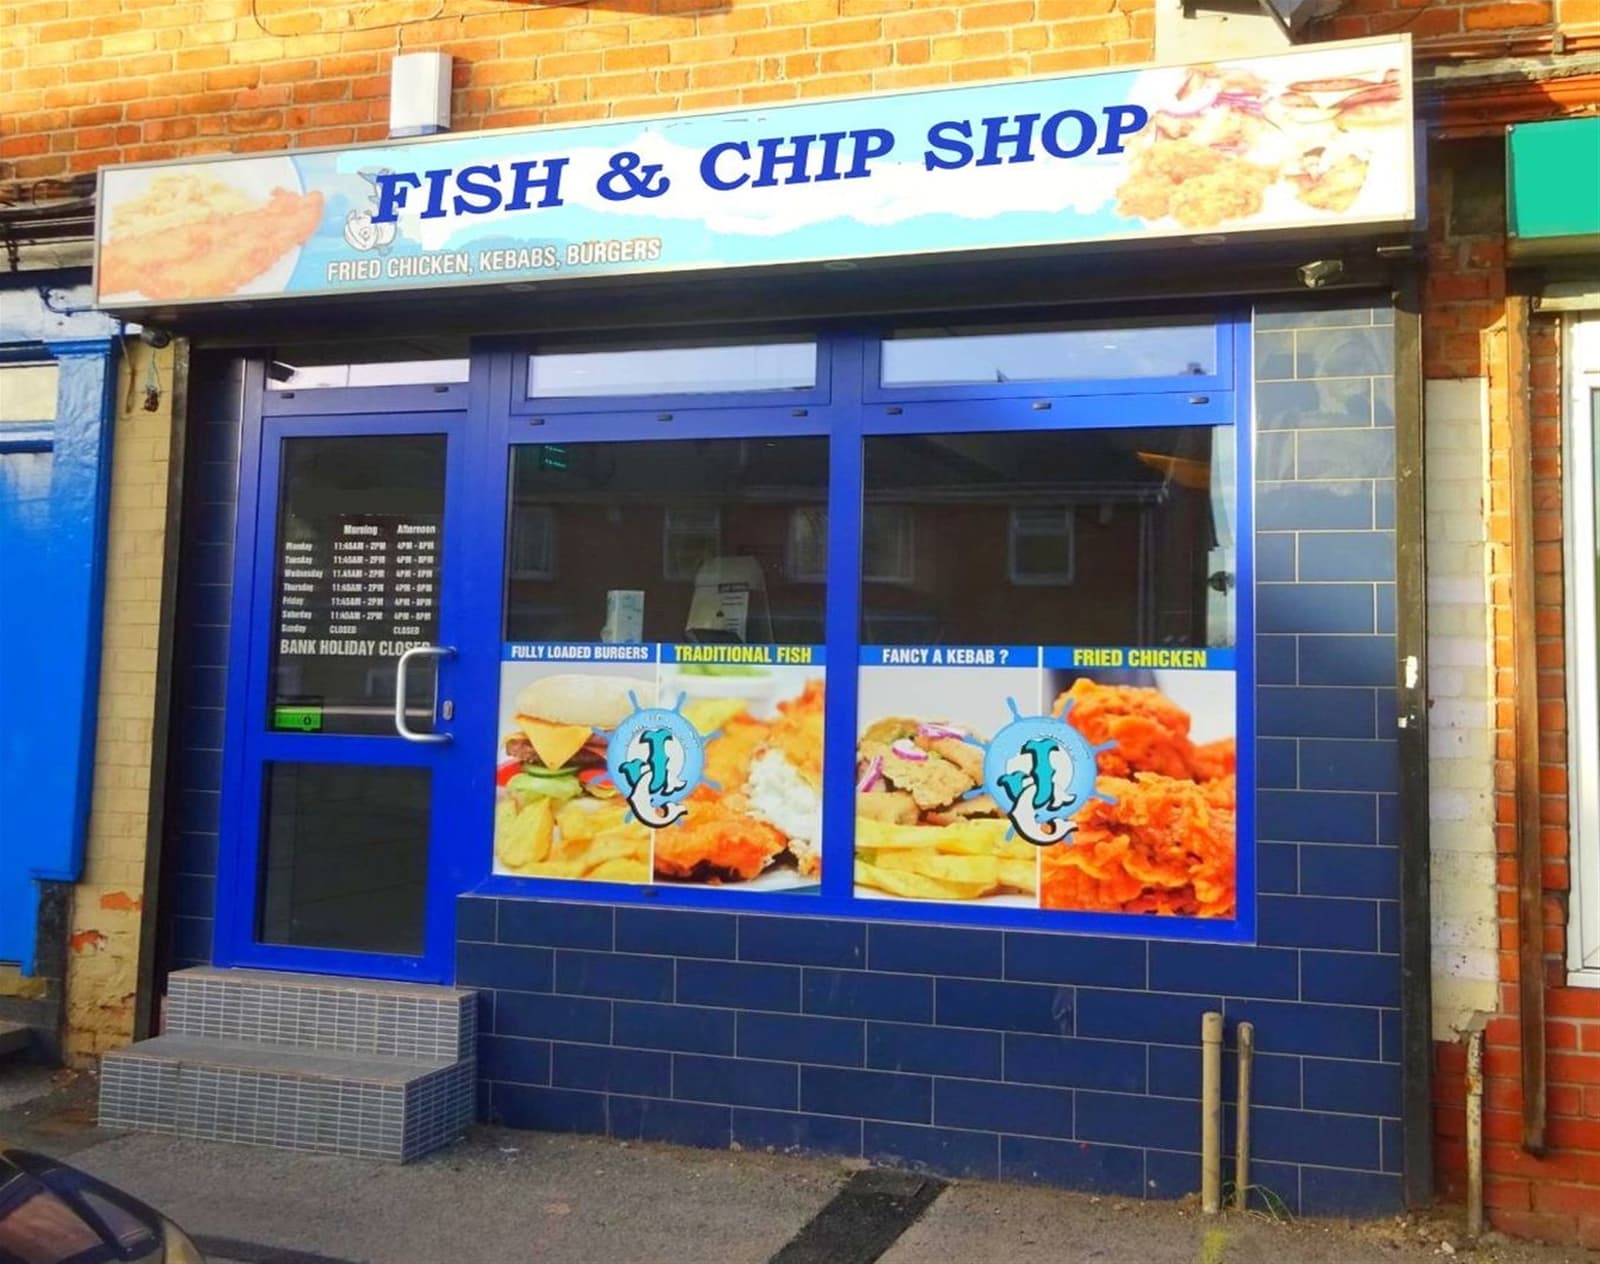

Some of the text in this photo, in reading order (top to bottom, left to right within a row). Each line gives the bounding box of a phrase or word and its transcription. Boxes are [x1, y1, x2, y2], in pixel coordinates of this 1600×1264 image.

[371, 104, 1149, 225] FISH & CHIP SHOP
[328, 238, 662, 281] FRIED CHICKEN, KEBABS, BURGERS
[344, 524, 436, 535] Morning Afternoon
[286, 542, 313, 551] Monday
[285, 555, 313, 564] Tuesday
[284, 570, 323, 578] Wednesday
[283, 583, 313, 592] Thursday
[282, 597, 304, 606] Friday
[282, 611, 312, 619] Saturday
[281, 624, 420, 635] Sunday CLOSED CLOSED
[280, 639, 316, 654] BANK
[320, 640, 376, 656] HOLIDAY
[511, 645, 649, 660] FULLY LOADED BURGERS
[675, 645, 811, 663] TRADITIONAL FISH
[882, 649, 1009, 665] FANCY A KEBAB ?
[1073, 649, 1207, 668] FRIED CHICKEN
